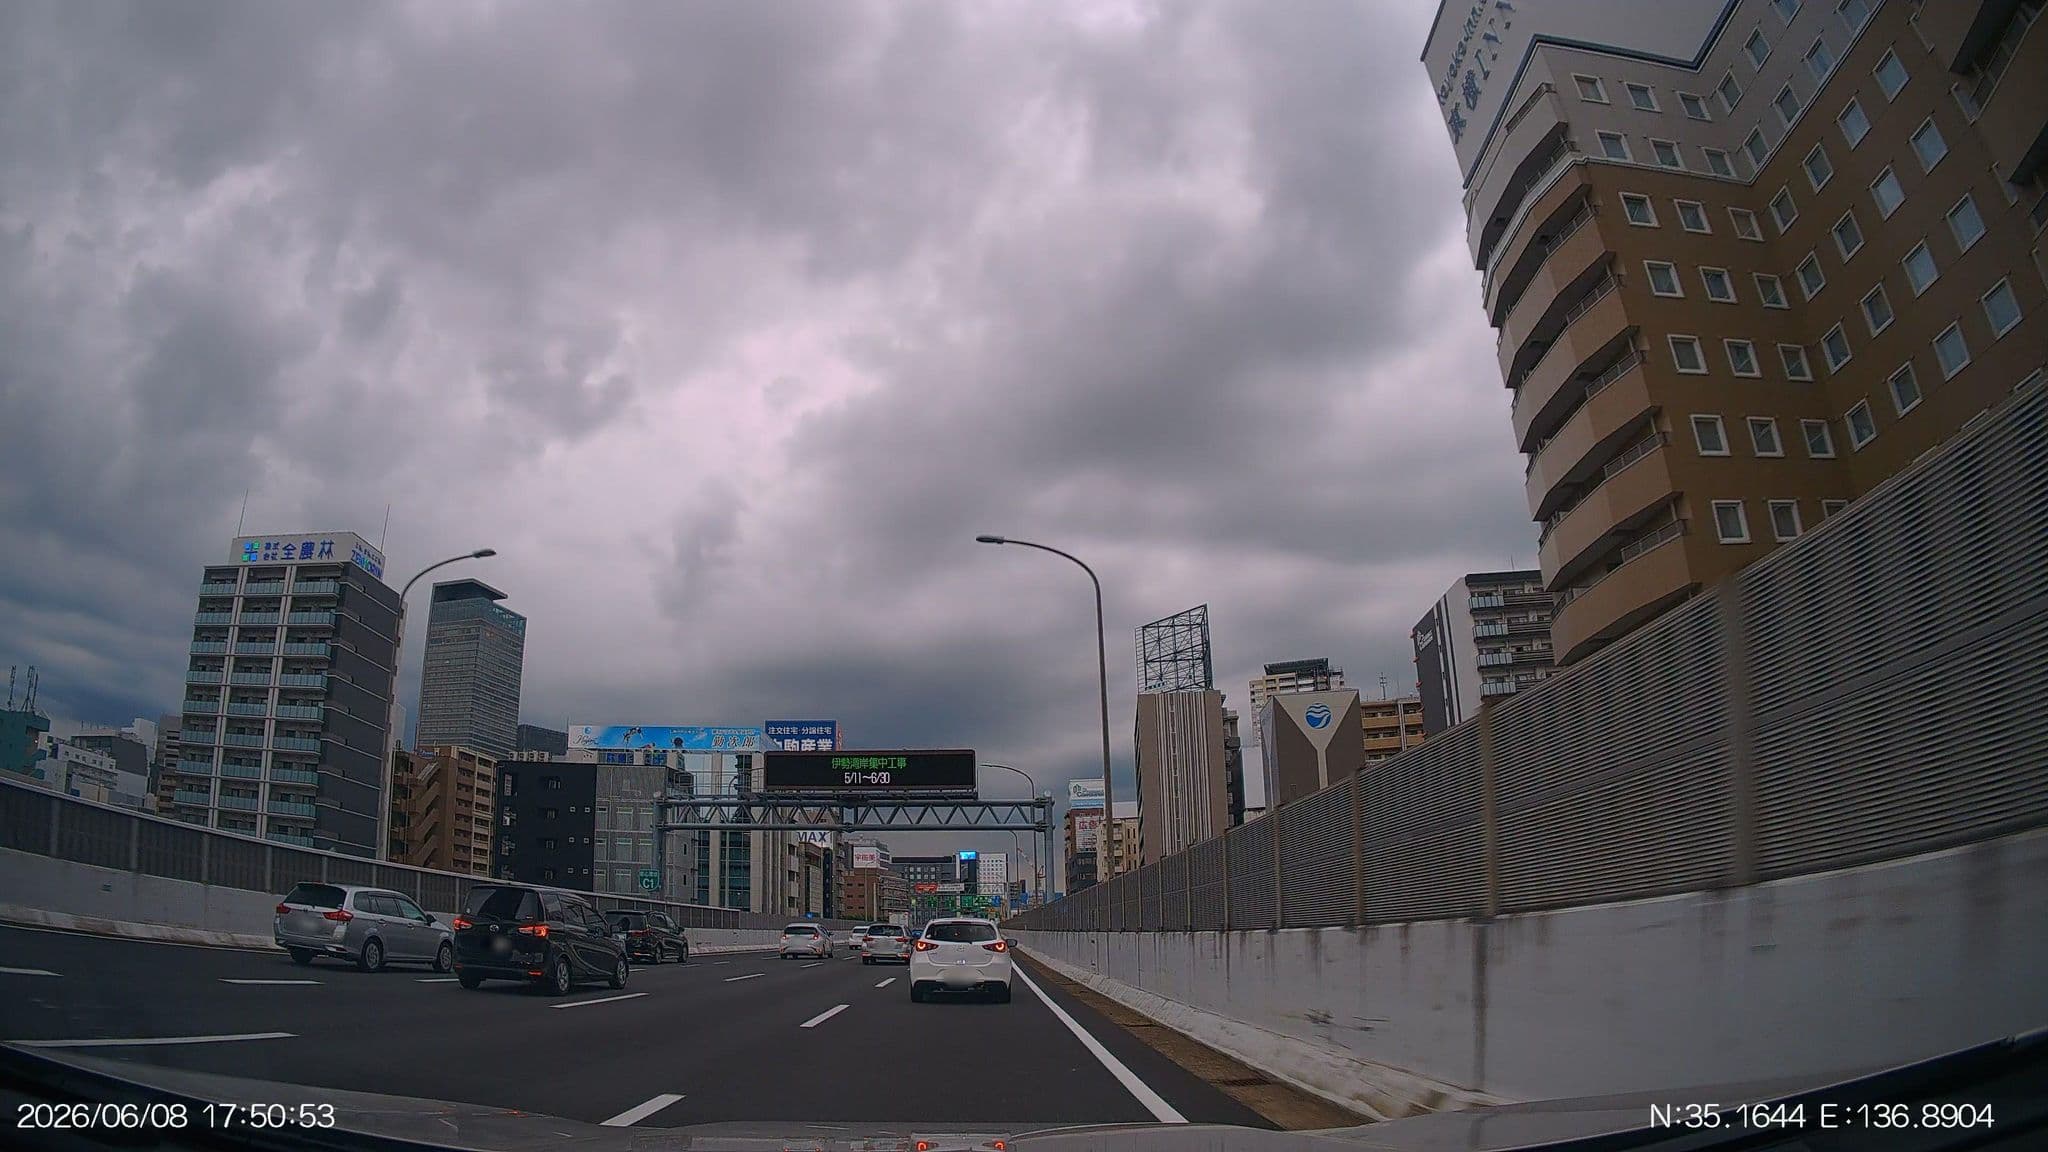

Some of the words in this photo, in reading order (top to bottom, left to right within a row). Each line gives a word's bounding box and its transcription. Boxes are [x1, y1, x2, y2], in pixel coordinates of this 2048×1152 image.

[280, 539, 335, 561] 全農林
[831, 757, 908, 770] 伊勢湾岸集中工事
[643, 878, 654, 889] C1
